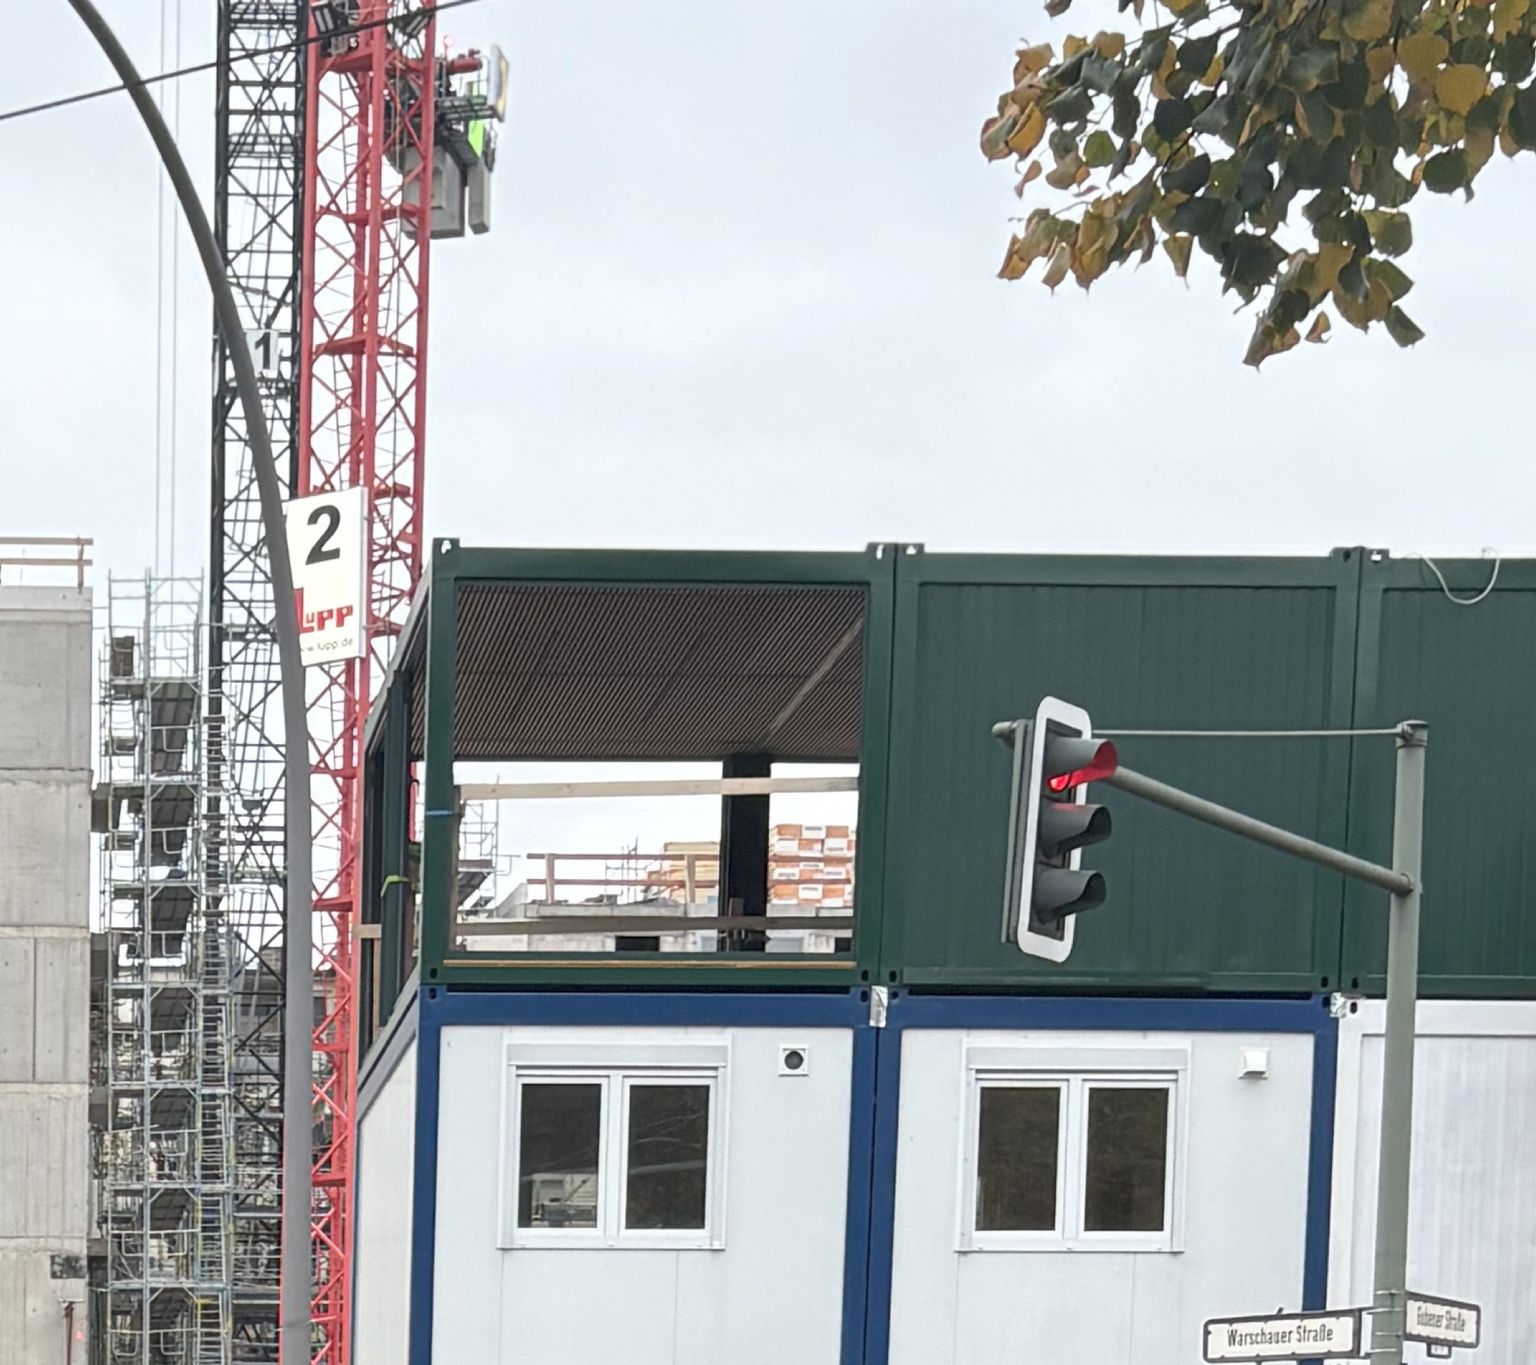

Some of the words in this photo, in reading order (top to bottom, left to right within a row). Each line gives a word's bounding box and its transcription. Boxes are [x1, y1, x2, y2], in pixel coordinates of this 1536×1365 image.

[255, 331, 270, 370] 1
[305, 504, 341, 566] 2
[1227, 1327, 1294, 1348] Warschauer
[1296, 1323, 1333, 1343] Straße
